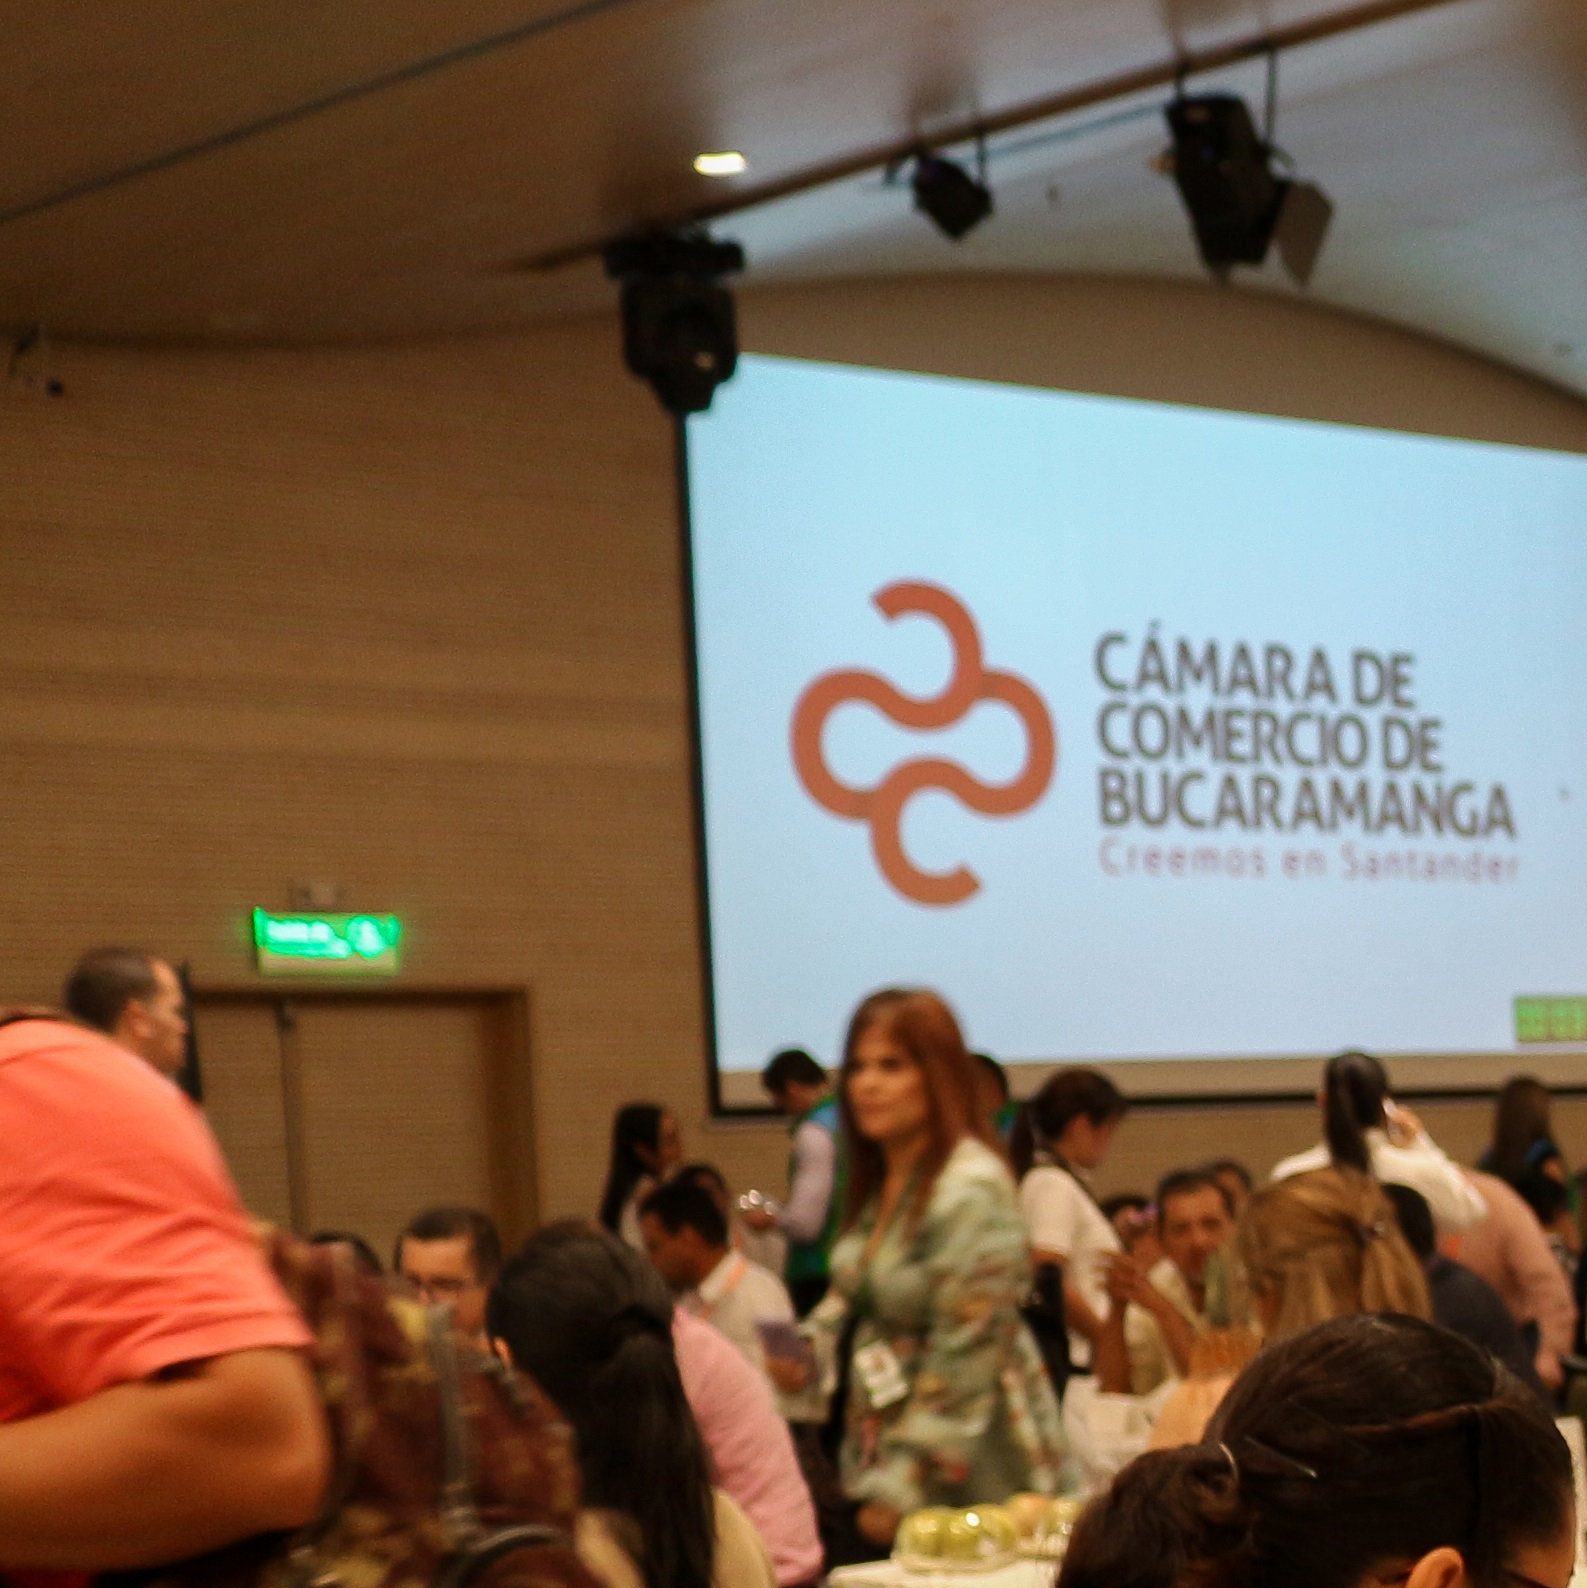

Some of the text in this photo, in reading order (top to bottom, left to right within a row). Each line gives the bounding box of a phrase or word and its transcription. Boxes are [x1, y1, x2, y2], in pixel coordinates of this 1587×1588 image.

[1094, 621, 1416, 707] CÁMARA DE
[1097, 702, 1444, 772] COMERCIO DE
[1099, 769, 1516, 837] BUCARAMANGA
[1100, 837, 1519, 882] Creemos en Santander
